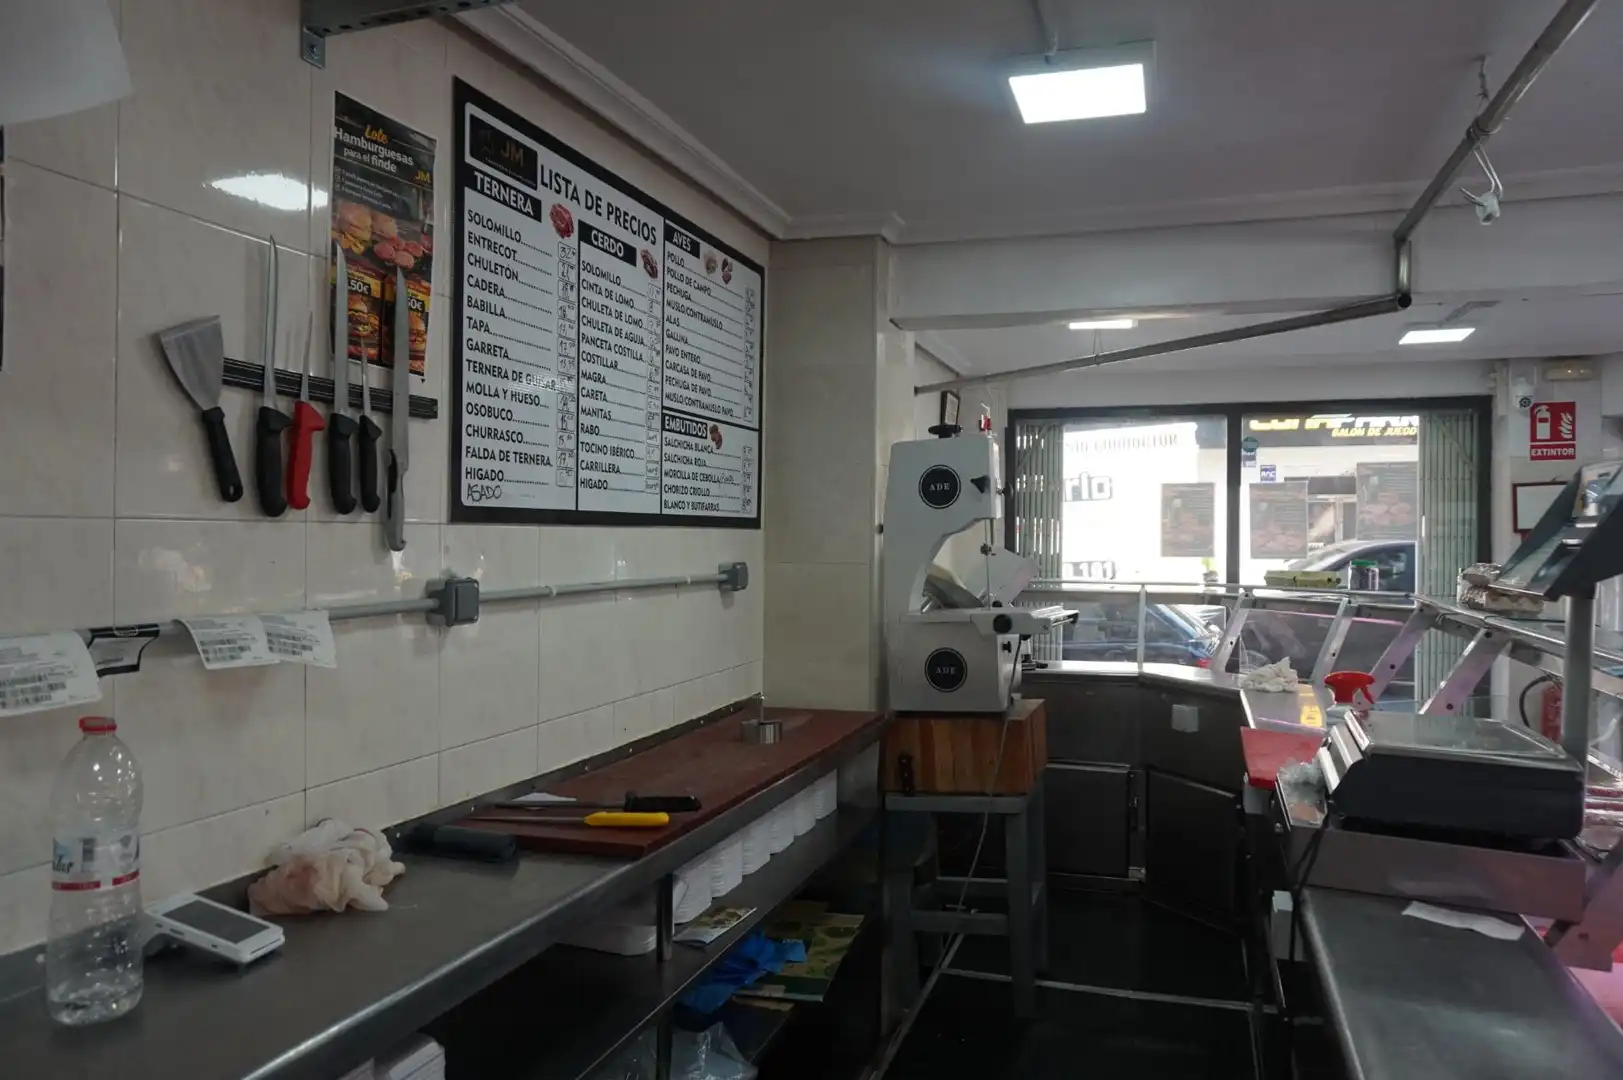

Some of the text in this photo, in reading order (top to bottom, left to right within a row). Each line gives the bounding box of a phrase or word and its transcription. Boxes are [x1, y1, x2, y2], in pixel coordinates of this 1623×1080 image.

[335, 127, 414, 166] Hamburguesas
[500, 139, 524, 168] JM
[344, 148, 397, 173] para el finde
[414, 170, 431, 183] JM
[474, 170, 534, 217] TERNERA
[540, 164, 580, 206] LISTA
[585, 190, 602, 217] DE
[606, 202, 656, 246] PRECIOS
[468, 210, 522, 243] SOLOMILLO
[468, 231, 516, 261] ENTRECOT
[590, 228, 624, 258] CERDO
[672, 230, 692, 252] AVES
[467, 252, 518, 282] CHULETÓN
[667, 250, 684, 268] POLLO
[582, 260, 622, 287] SOLOMILLO
[667, 266, 712, 297] POLLO DE CAMPO
[467, 274, 505, 298] CADERA
[582, 278, 602, 296] CINTA
[604, 288, 614, 300] DE
[614, 292, 634, 310] LOMO
[666, 282, 692, 302] PECHUGA
[467, 294, 506, 318] BABILLA
[582, 296, 613, 318] CHULETA
[614, 309, 623, 321] DE
[624, 313, 643, 329] LOMO
[466, 316, 490, 334] TAPA
[582, 315, 613, 335] CHULETA
[614, 326, 624, 338] DE
[624, 330, 644, 346] AGUJA
[666, 315, 680, 328] ALAS
[666, 328, 688, 345] GALLINA
[466, 338, 510, 360] GARRETA
[582, 333, 612, 352] PANCETA
[614, 344, 644, 363] COSTILLA
[666, 344, 700, 364] PAVO ENTERO
[582, 350, 618, 370] COSTILLAR
[466, 359, 509, 380] TERNERA
[512, 370, 523, 382] DE
[526, 373, 556, 390] GUISAR
[581, 370, 606, 384] MAGRA
[666, 360, 712, 382] CARCASA DE PAVO
[466, 382, 500, 398] MOLLA
[502, 388, 508, 400] Y
[511, 390, 540, 406] HUESO
[581, 387, 608, 402] CARETA
[666, 376, 712, 396] PECHUGA DE PAVO
[466, 402, 513, 422] OSOBUCO
[580, 406, 612, 421] MANITAS
[722, 404, 734, 417] PAVO
[466, 424, 524, 444] CHURRASCO
[580, 422, 600, 436] RABO
[664, 415, 708, 438] EMBUTIDOS
[1367, 427, 1382, 436] DE
[1384, 427, 1416, 436] JUEGO
[580, 442, 634, 460] TOCINO IBÉRICO
[664, 436, 714, 454] SALCHICHA BLANCA
[1531, 448, 1576, 456] EXTINTOR
[466, 446, 496, 461] FALDA
[499, 450, 510, 462] DE
[514, 452, 552, 466] TERNERA
[664, 452, 707, 468] SALCHICHA ROJA
[466, 467, 504, 482] HIGADO
[580, 460, 621, 474] CARRILLERA
[664, 468, 690, 480] MORCILLA
[692, 472, 698, 482] DE
[699, 473, 720, 484] CEBOLLA
[467, 483, 502, 502] ASADO
[580, 478, 608, 490] HIGADO
[664, 484, 711, 498] CHORIZO CRIOLLO
[928, 482, 950, 492] ADE
[664, 500, 720, 512] BLANCO Y BUTIFARRAS
[936, 666, 957, 675] ADE
